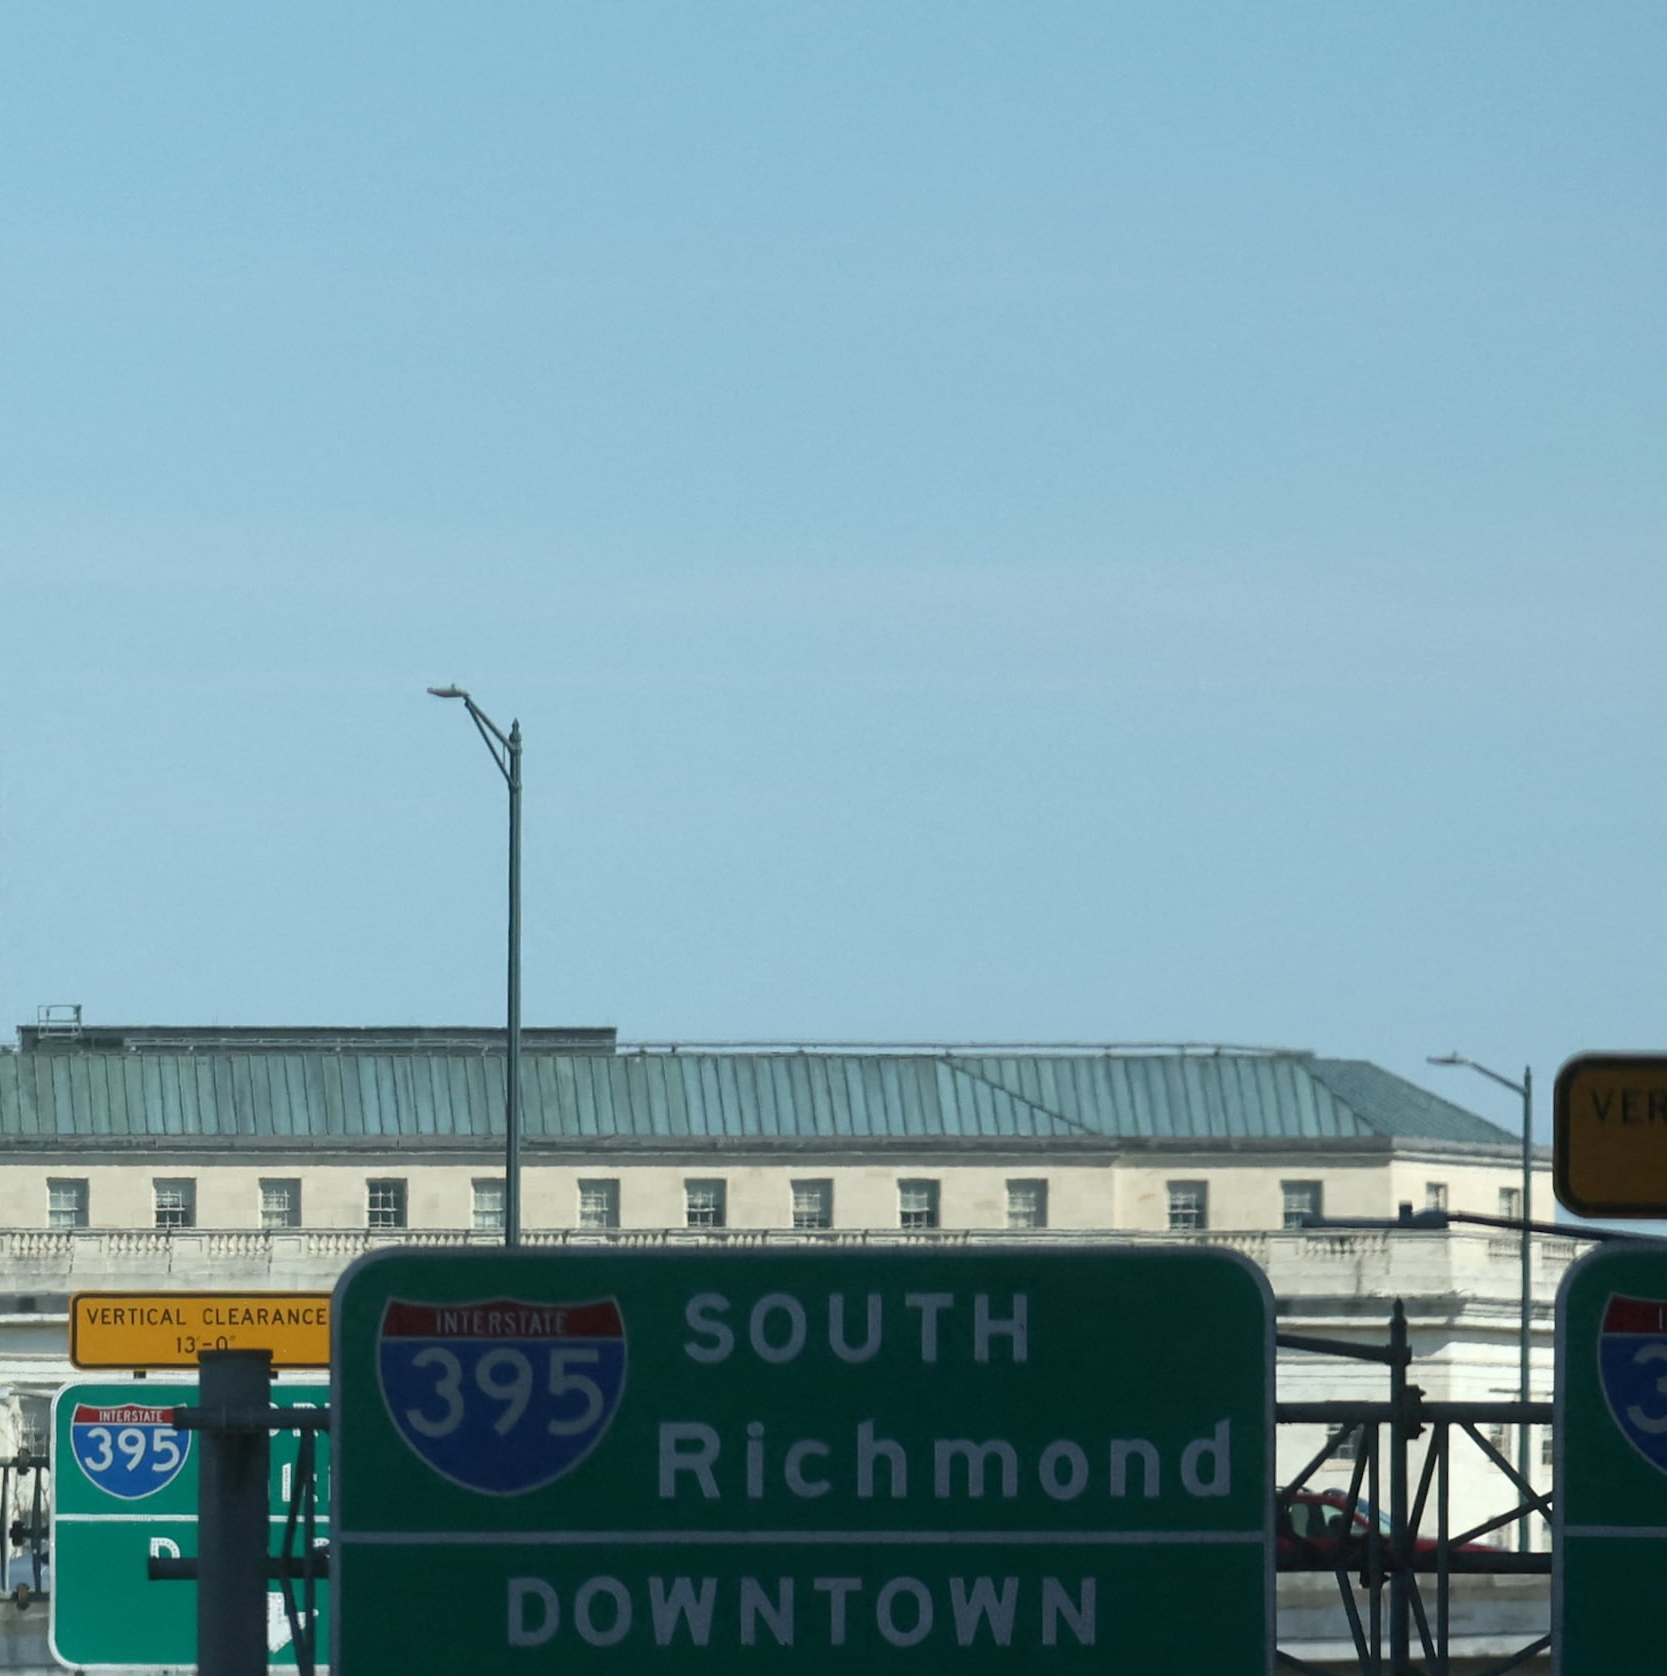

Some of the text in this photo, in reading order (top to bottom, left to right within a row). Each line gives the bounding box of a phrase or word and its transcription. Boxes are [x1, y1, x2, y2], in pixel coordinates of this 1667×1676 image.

[87, 1307, 327, 1326] VERTICAL CLEARANCE
[436, 1310, 566, 1334] INTERSTATE
[683, 1292, 1028, 1364] SOUTH
[99, 1410, 163, 1423] INTERSTATE
[405, 1346, 605, 1438] 395
[84, 1427, 181, 1473] 395
[658, 1417, 1233, 1501] Richmond
[507, 1575, 1096, 1646] DOWNTOWN
